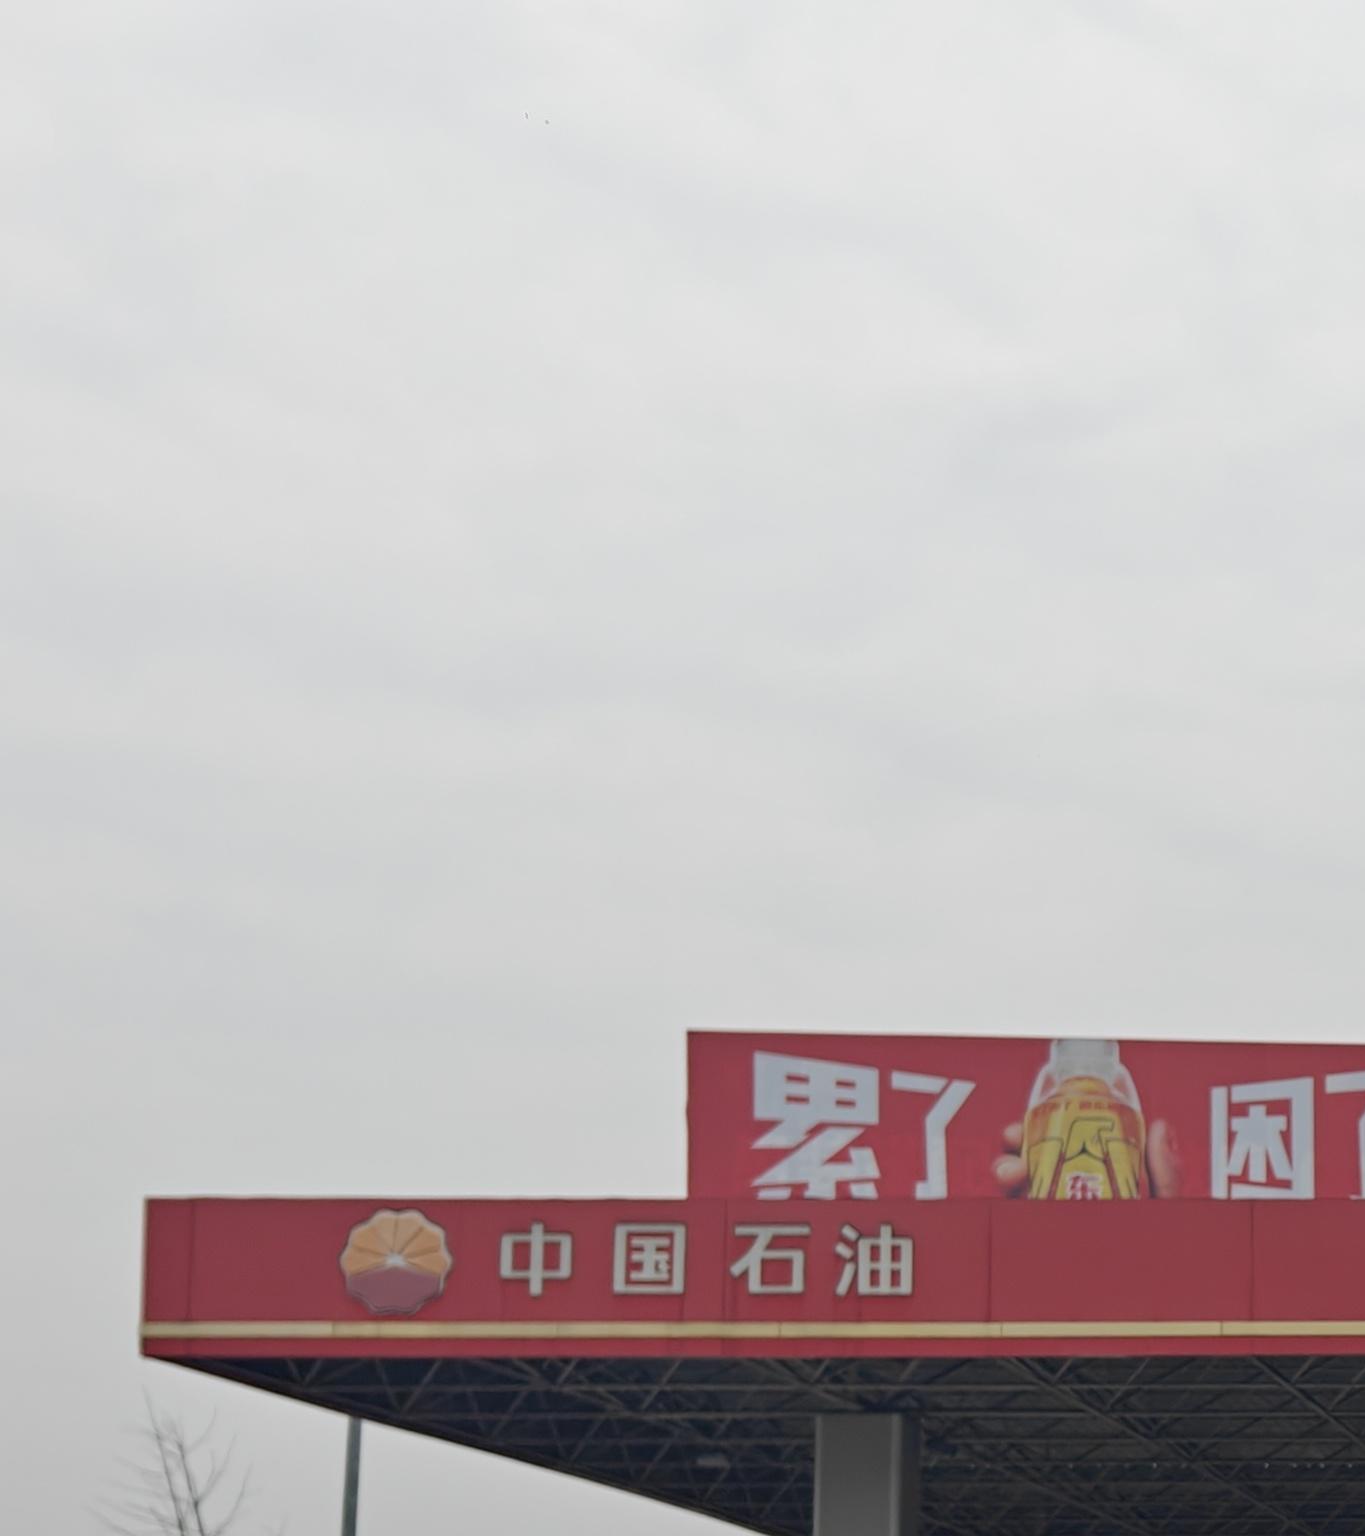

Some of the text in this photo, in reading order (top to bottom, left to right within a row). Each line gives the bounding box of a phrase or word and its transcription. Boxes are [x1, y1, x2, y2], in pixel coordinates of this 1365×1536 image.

[752, 1050, 976, 1200] 累了
[499, 1220, 914, 1298] 中国石油
